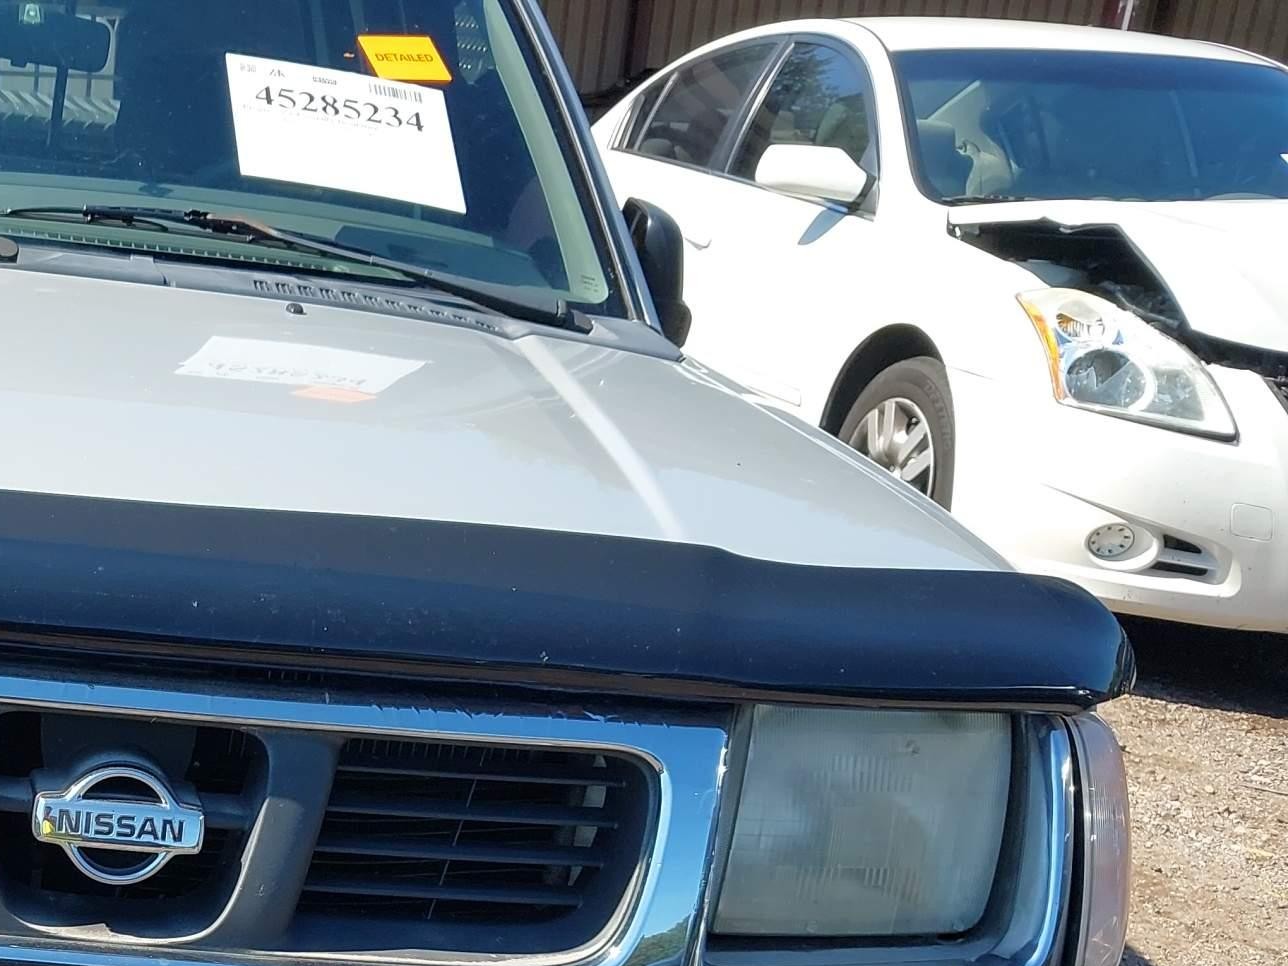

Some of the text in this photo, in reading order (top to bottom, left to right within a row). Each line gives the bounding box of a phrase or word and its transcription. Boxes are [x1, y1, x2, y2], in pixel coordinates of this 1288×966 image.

[375, 53, 434, 63] DETAILED
[255, 86, 425, 132] 45285234
[57, 808, 184, 842] NISSAN
